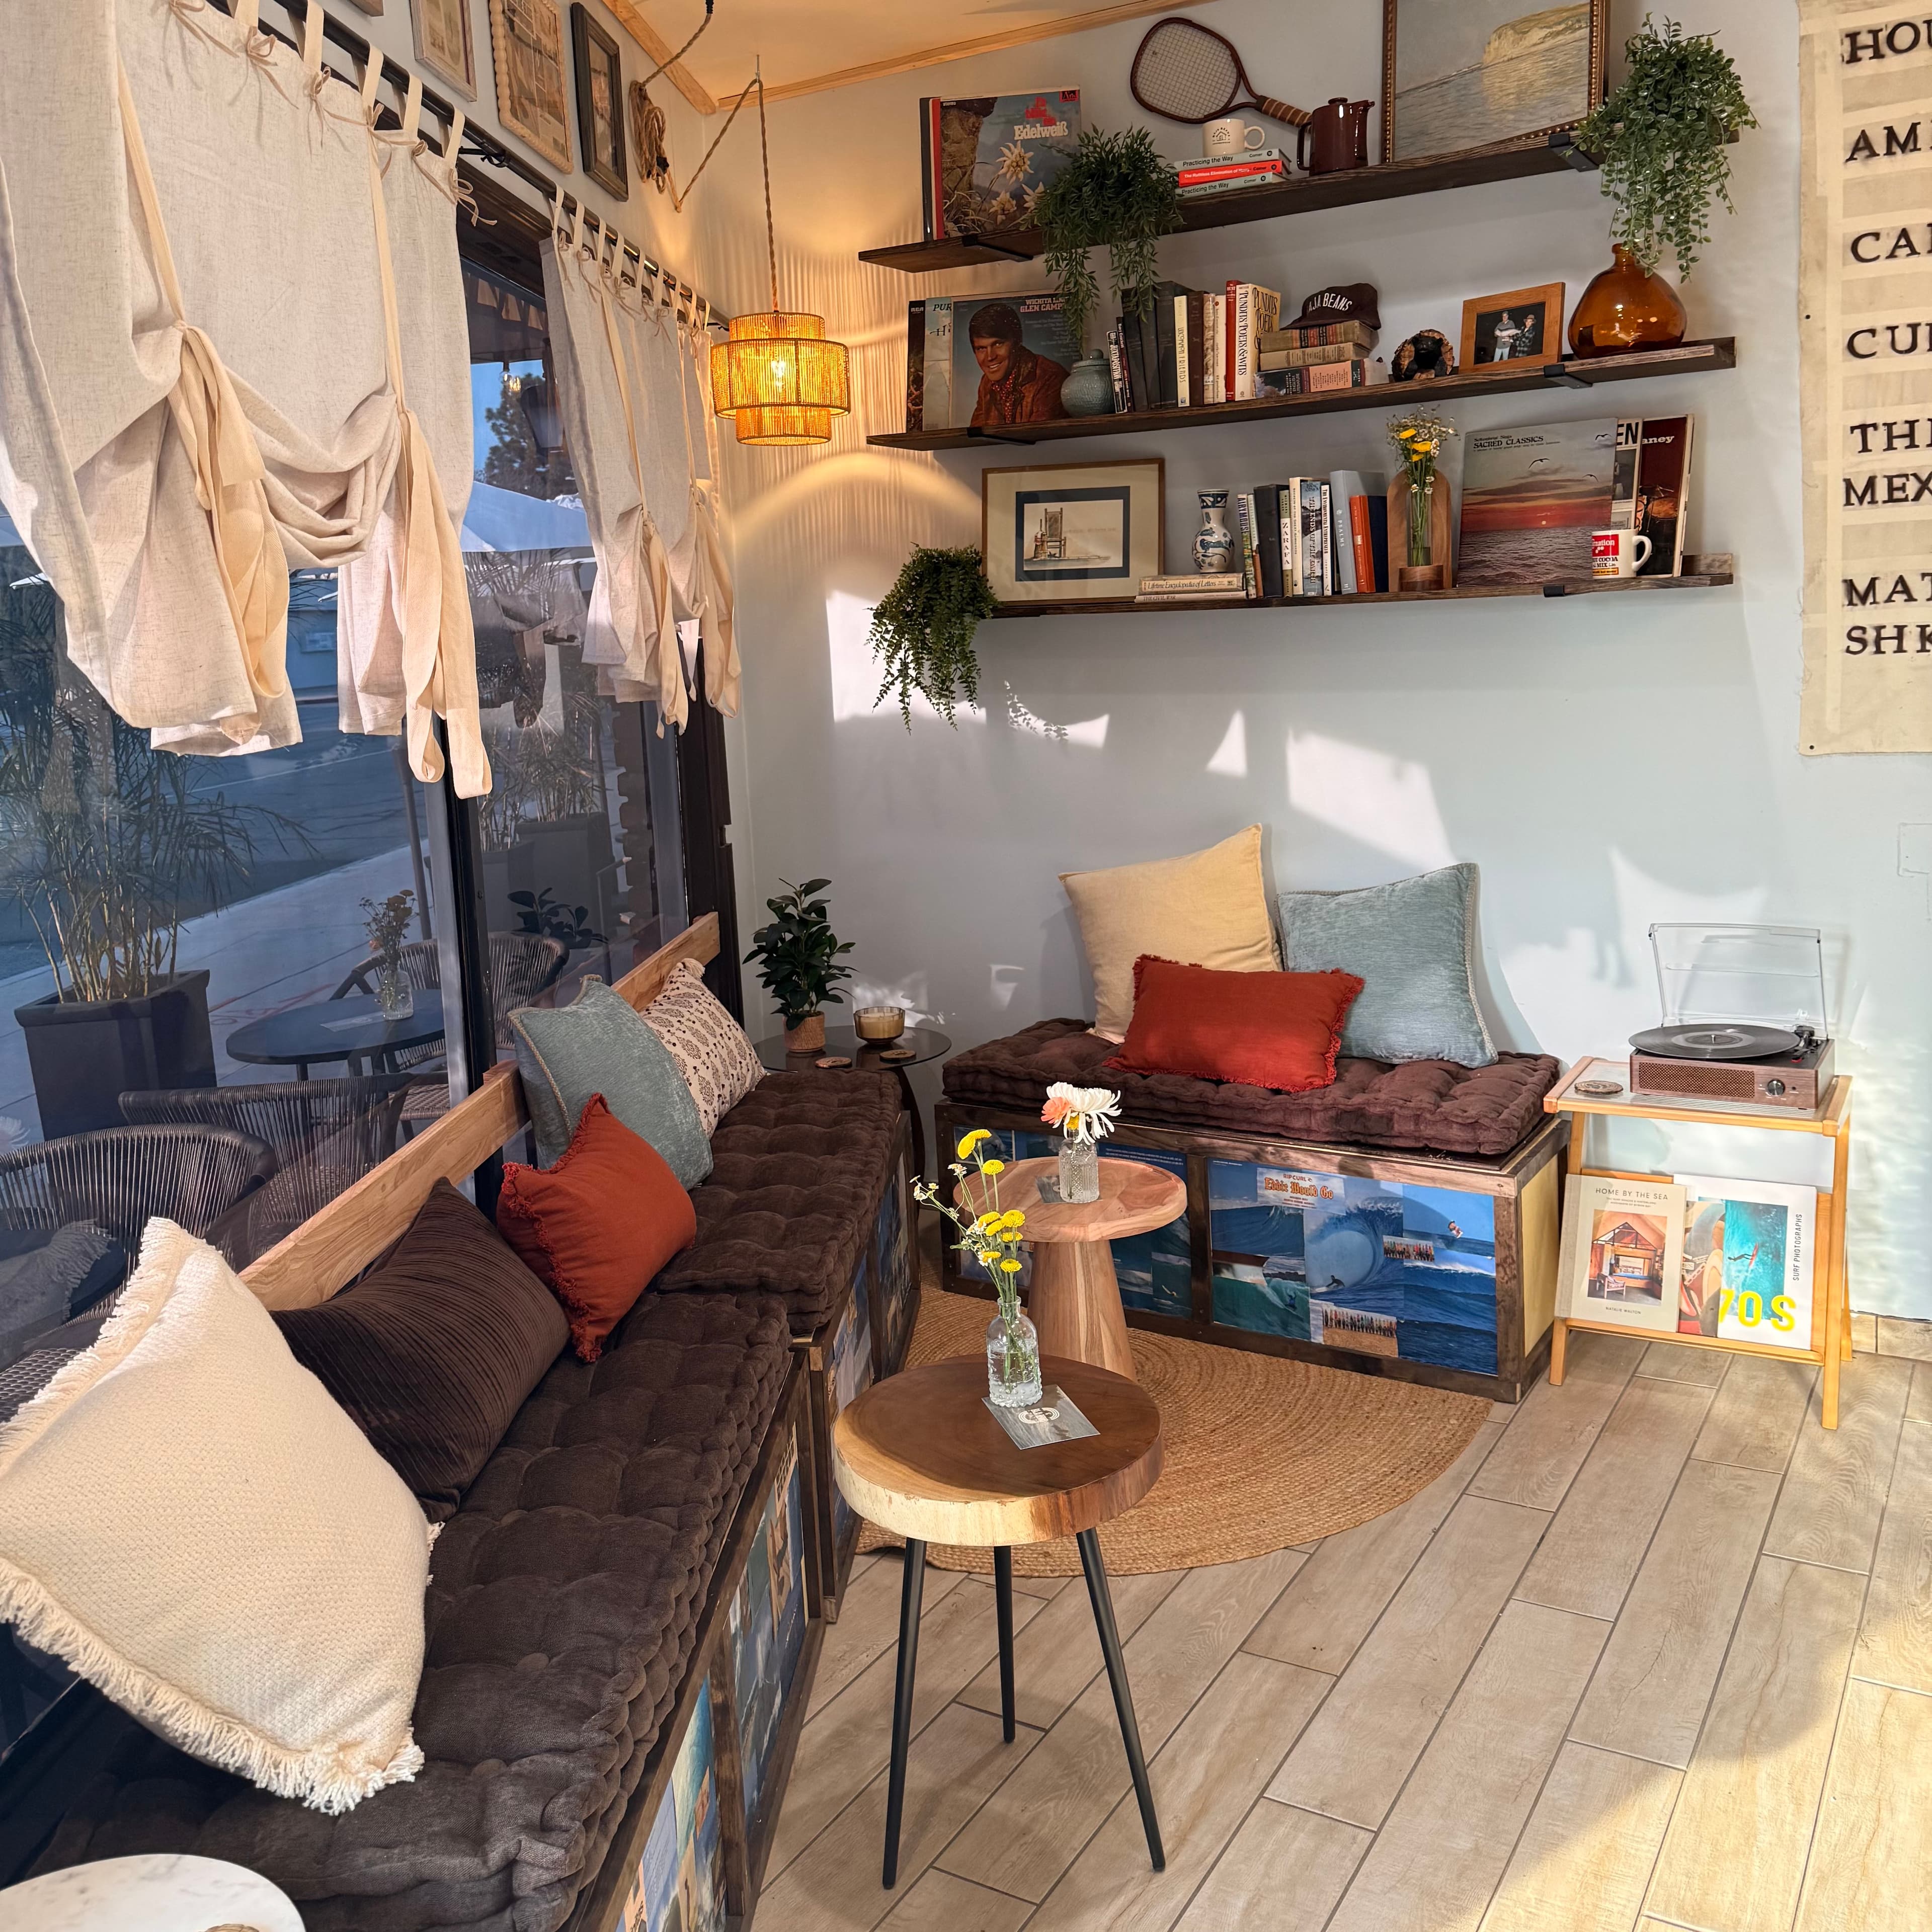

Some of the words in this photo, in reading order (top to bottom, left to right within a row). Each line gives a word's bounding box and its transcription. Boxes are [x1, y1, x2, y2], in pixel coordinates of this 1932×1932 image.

[1014, 121, 1069, 140] Edelweiß
[1844, 121, 1932, 163] AM
[1183, 157, 1210, 167] Practicing
[1182, 186, 1207, 194] Practicing
[1850, 223, 1932, 263] CA
[1040, 303, 1063, 311] CAMP
[1239, 290, 1249, 323] PUNDITS
[1252, 287, 1278, 315] PUNDITS
[1309, 295, 1322, 312] AJA
[1322, 293, 1353, 311] BEANS
[1239, 323, 1248, 348] POETS
[1110, 344, 1122, 380] JUXTAPOSITION
[1239, 356, 1247, 376] WITS
[1473, 440, 1503, 449] SACRED
[1506, 436, 1544, 445] CLASSICS
[1850, 418, 1932, 453] TH
[1310, 533, 1316, 542] OF
[1148, 582, 1165, 590] Lifetime
[1165, 581, 1194, 590] Encyclopedia
[1195, 580, 1201, 588] of
[1264, 1177, 1289, 1192] Eddie
[1290, 1181, 1318, 1197] Would
[1320, 1185, 1333, 1200] Go
[1794, 1214, 1803, 1262] PHOTOGRAPHS
[1793, 1263, 1801, 1281] SURF
[1718, 1288, 1797, 1332] 70S
